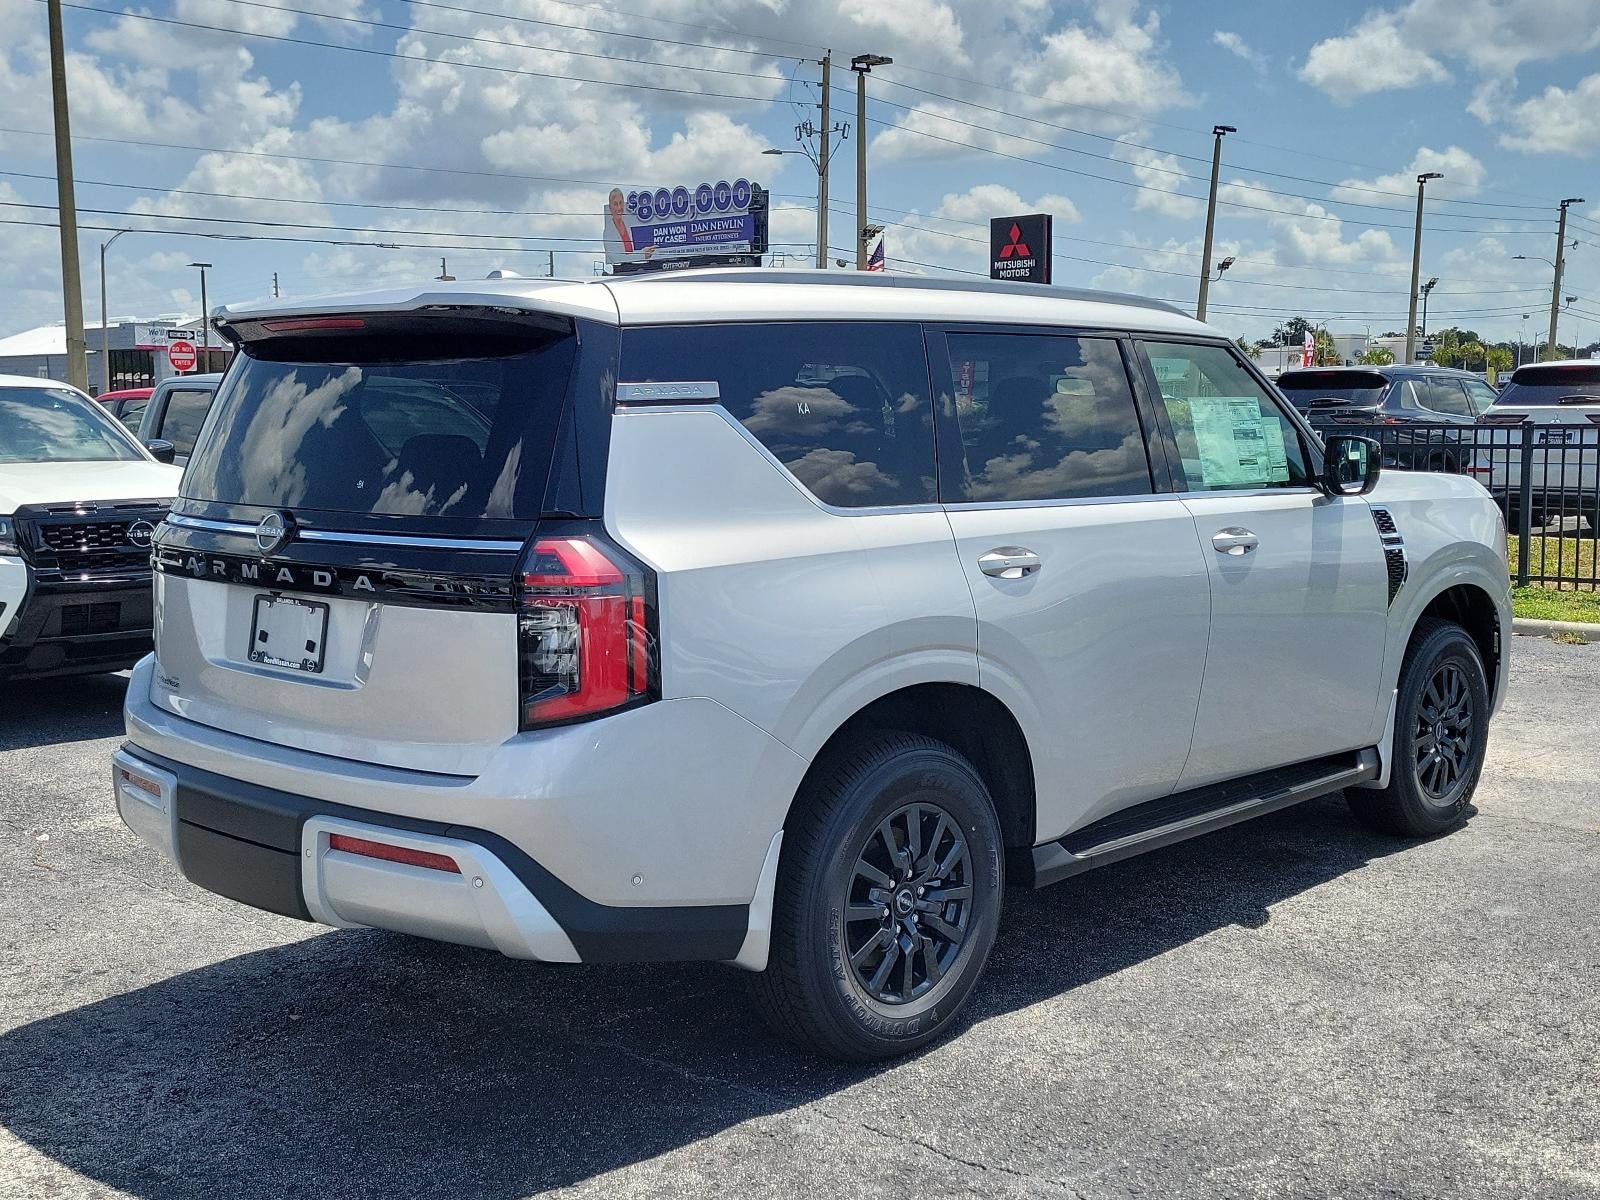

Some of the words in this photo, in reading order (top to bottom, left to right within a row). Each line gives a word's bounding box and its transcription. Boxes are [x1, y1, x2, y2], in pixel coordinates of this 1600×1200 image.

[627, 178, 752, 222] $800,000
[653, 228, 669, 237] DAN
[670, 226, 687, 235] WON
[691, 222, 711, 233] DAN
[711, 219, 744, 231] NEWLIN
[653, 237, 664, 245] MY
[994, 259, 1036, 270] MITSUBISHI
[999, 268, 1030, 278] MOTORS
[797, 402, 811, 415] KA
[186, 556, 376, 592] ARMADA
